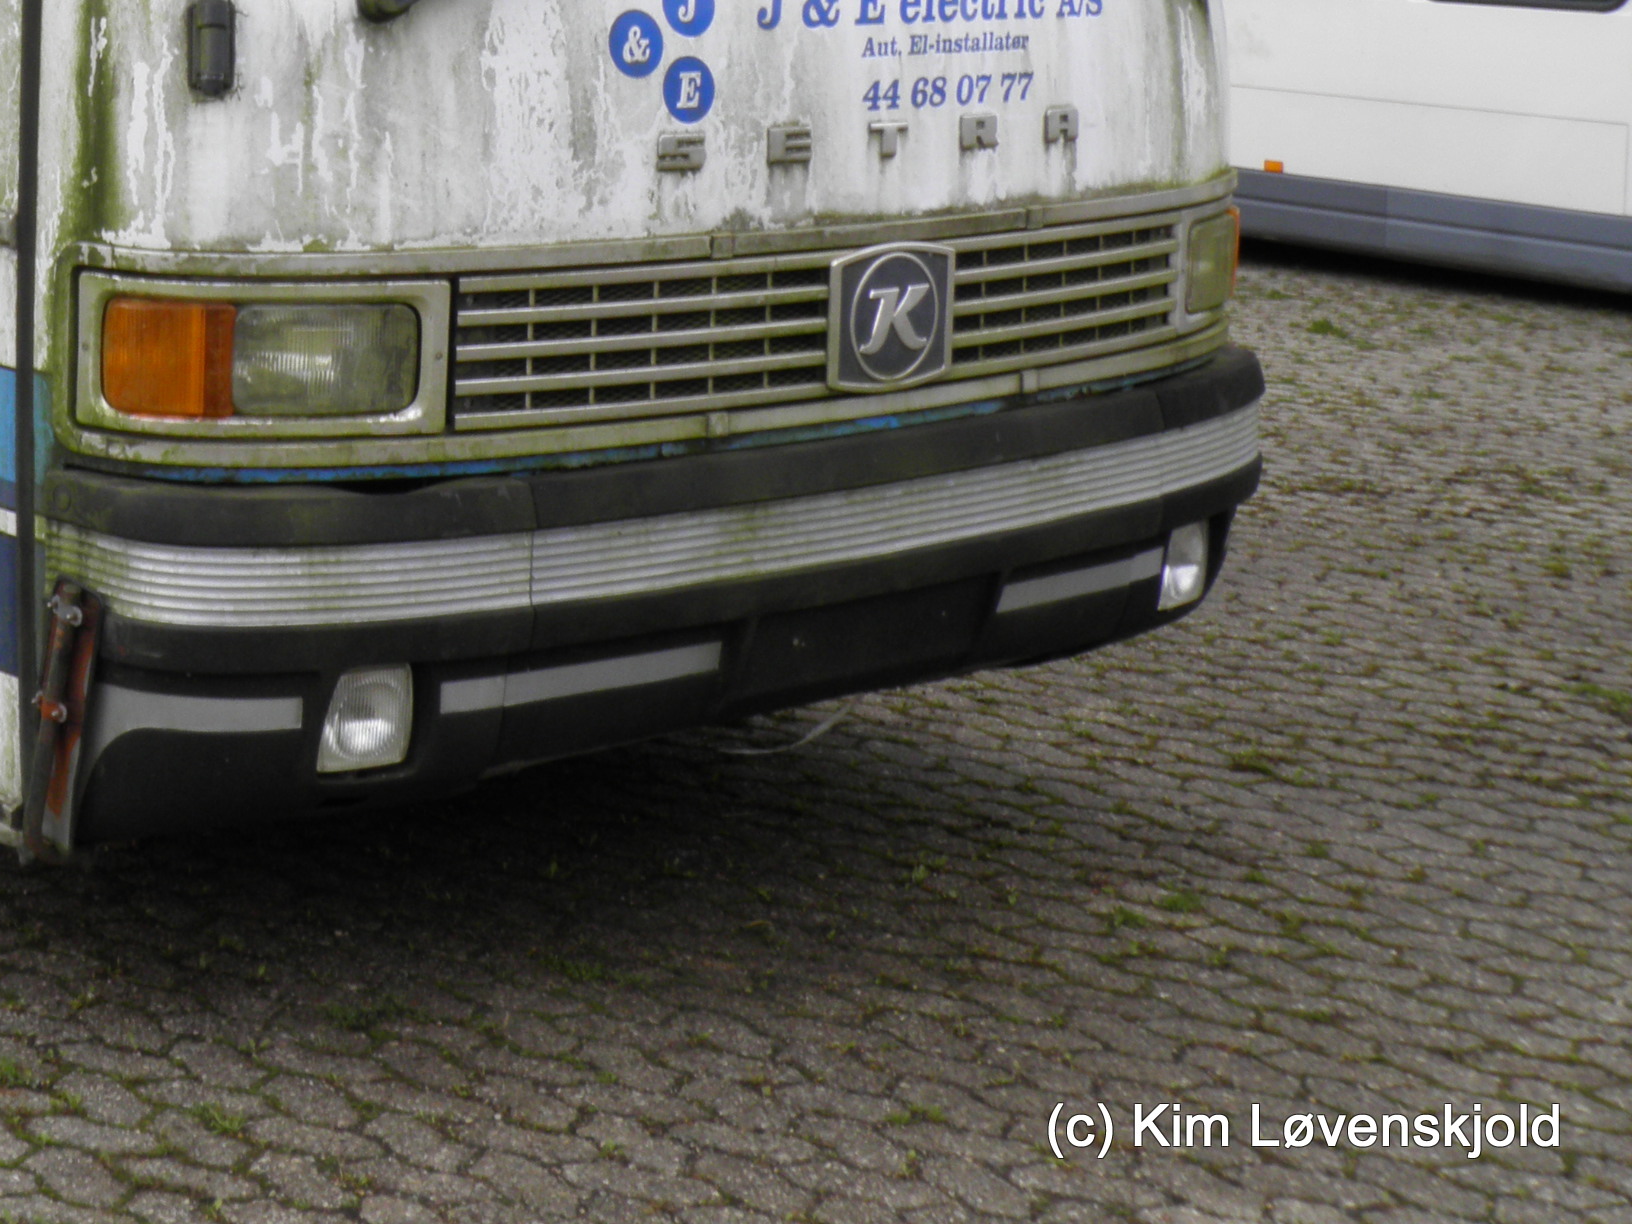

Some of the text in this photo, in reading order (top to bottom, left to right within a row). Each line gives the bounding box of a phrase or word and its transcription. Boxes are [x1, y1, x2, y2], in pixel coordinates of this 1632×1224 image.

[621, 24, 652, 65] &
[676, 71, 703, 110] E
[861, 31, 1030, 59] Aut. El-installatør
[862, 71, 1034, 112] 44 68 07 77
[656, 104, 1080, 173] SETRA
